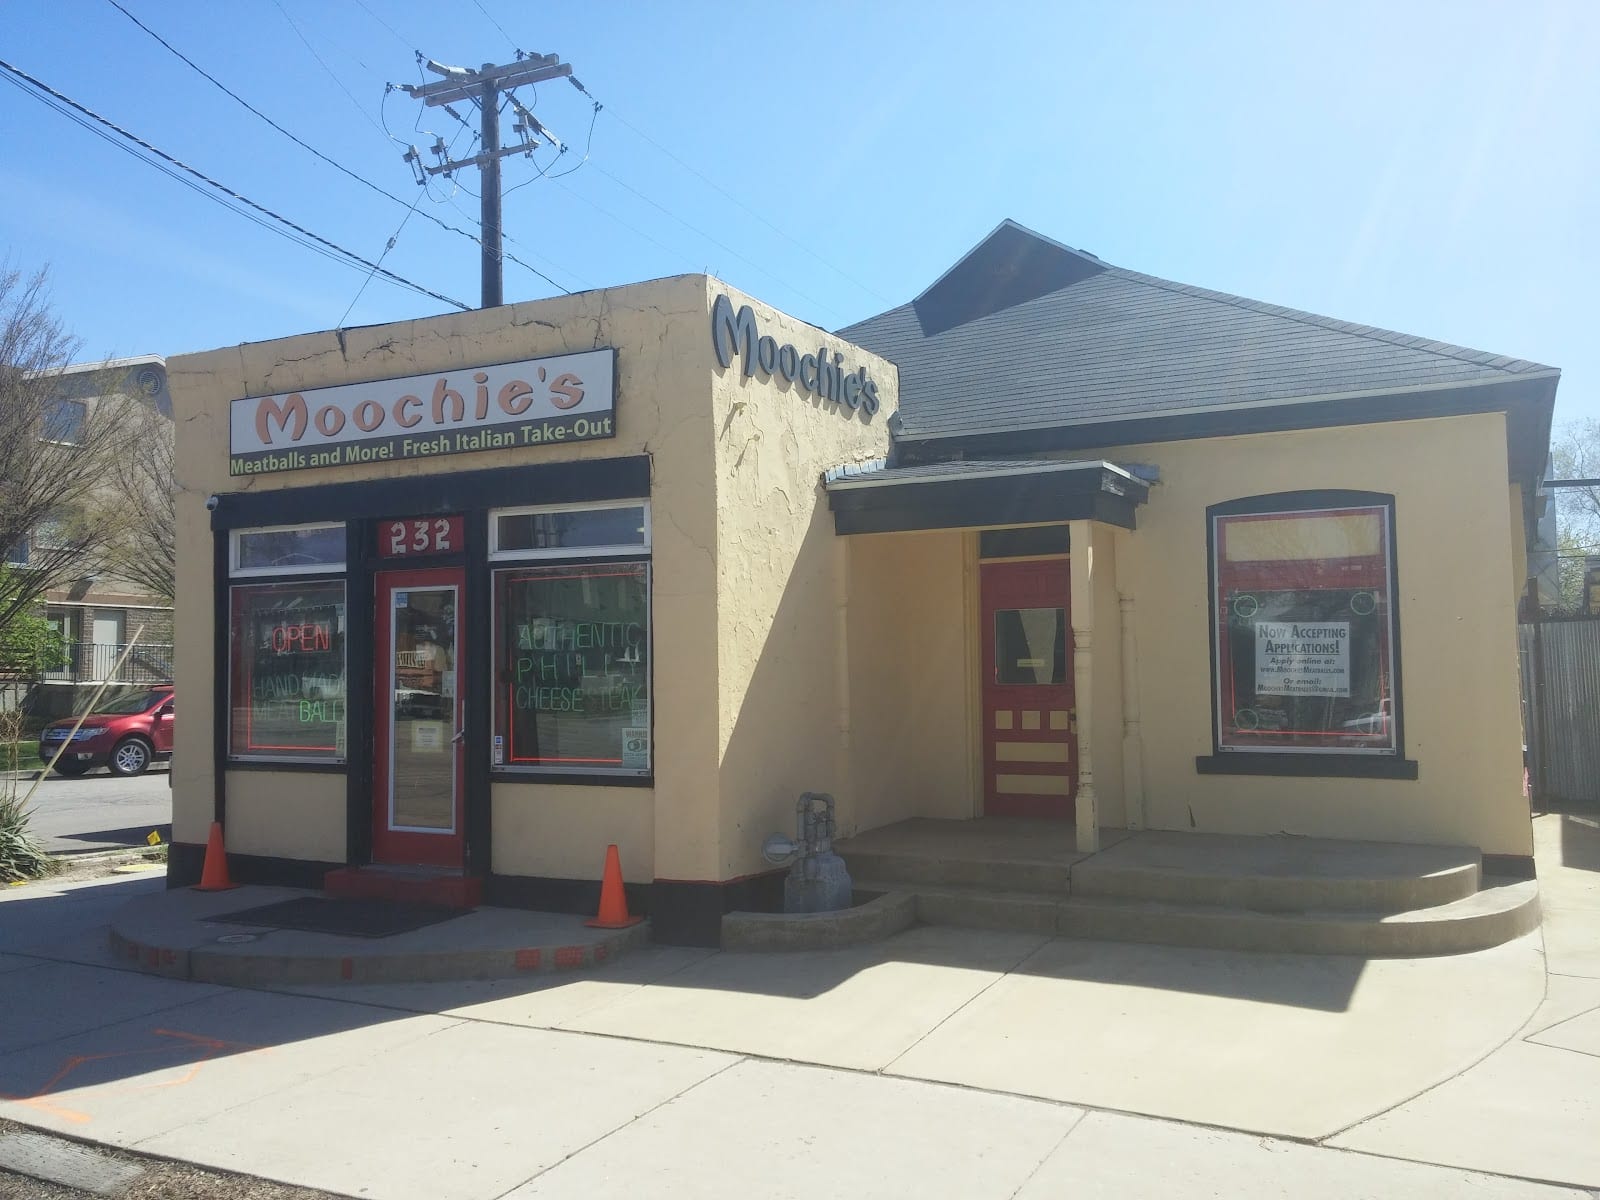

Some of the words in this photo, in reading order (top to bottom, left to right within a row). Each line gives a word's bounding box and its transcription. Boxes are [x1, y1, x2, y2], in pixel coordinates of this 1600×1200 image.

[712, 294, 880, 416] Moochie's
[255, 366, 585, 444] Moochie's
[230, 451, 306, 475] Meatballs
[310, 450, 340, 466] and
[345, 441, 394, 462] More!
[403, 435, 450, 457] Fresh
[456, 429, 515, 450] Italian
[520, 417, 612, 444] Take-Out
[390, 518, 450, 554] 232
[272, 623, 330, 652] OPEN
[518, 622, 641, 650] AUTHENTIC
[1259, 625, 1286, 638] NOW
[1291, 625, 1346, 639] ACCEPTING
[1265, 639, 1340, 654] APPLICATIONS!
